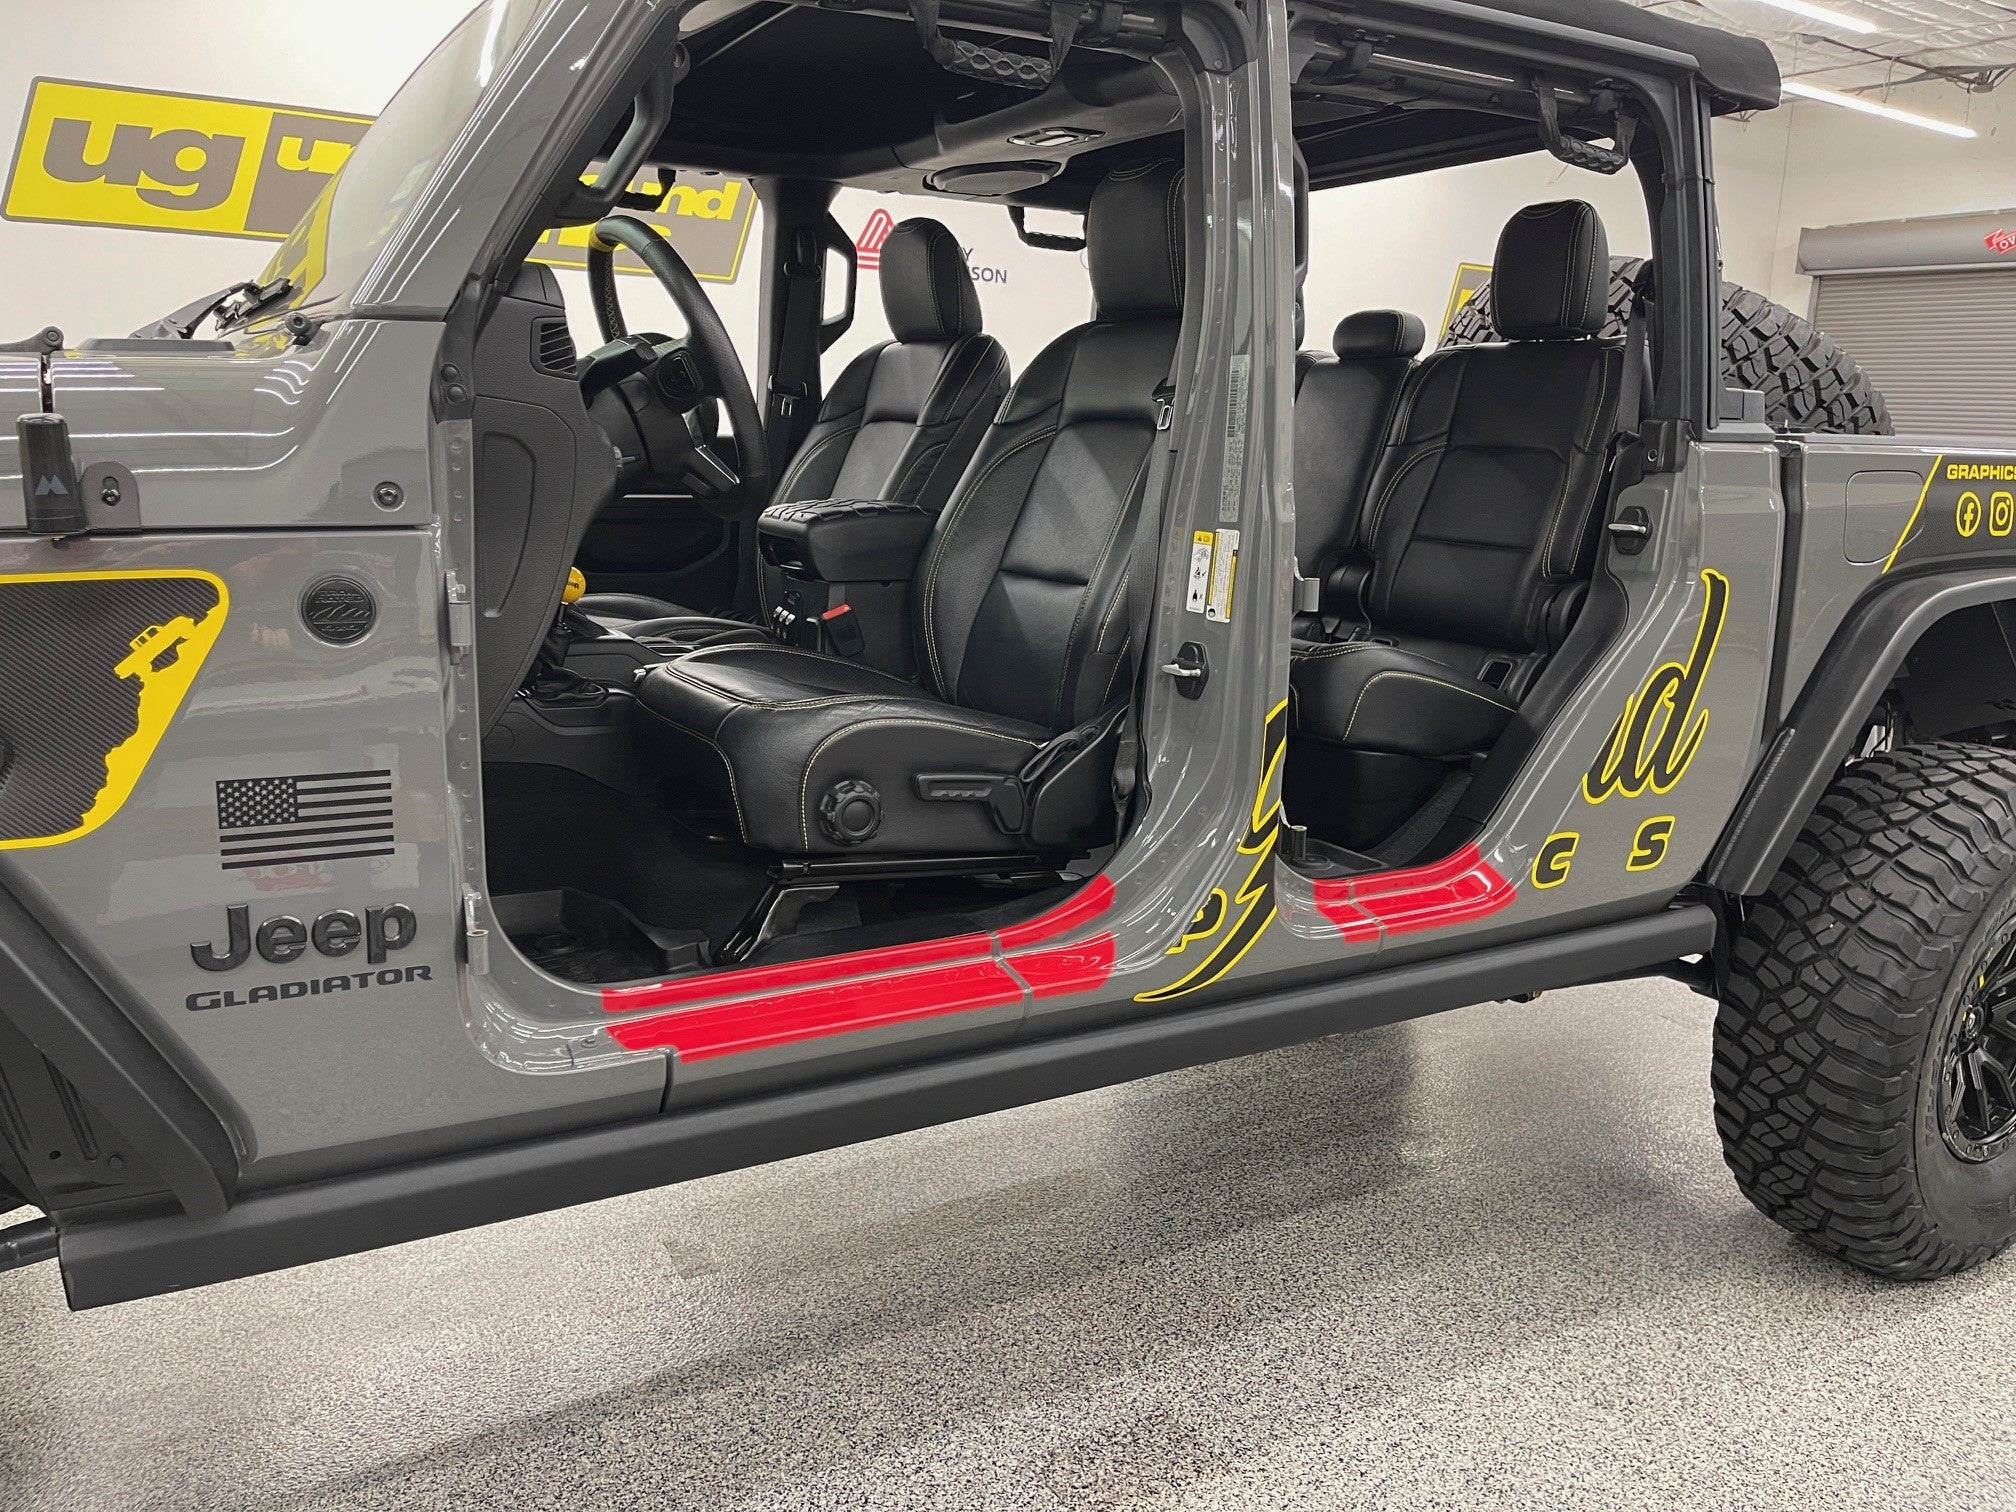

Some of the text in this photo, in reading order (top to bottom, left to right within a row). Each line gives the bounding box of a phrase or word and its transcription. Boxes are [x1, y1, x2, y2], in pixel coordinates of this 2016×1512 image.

[43, 117, 246, 212] ug
[1946, 463, 2016, 480] GRAPHIC
[190, 902, 417, 972] Jeep
[185, 965, 433, 1012] GLADIATOR
